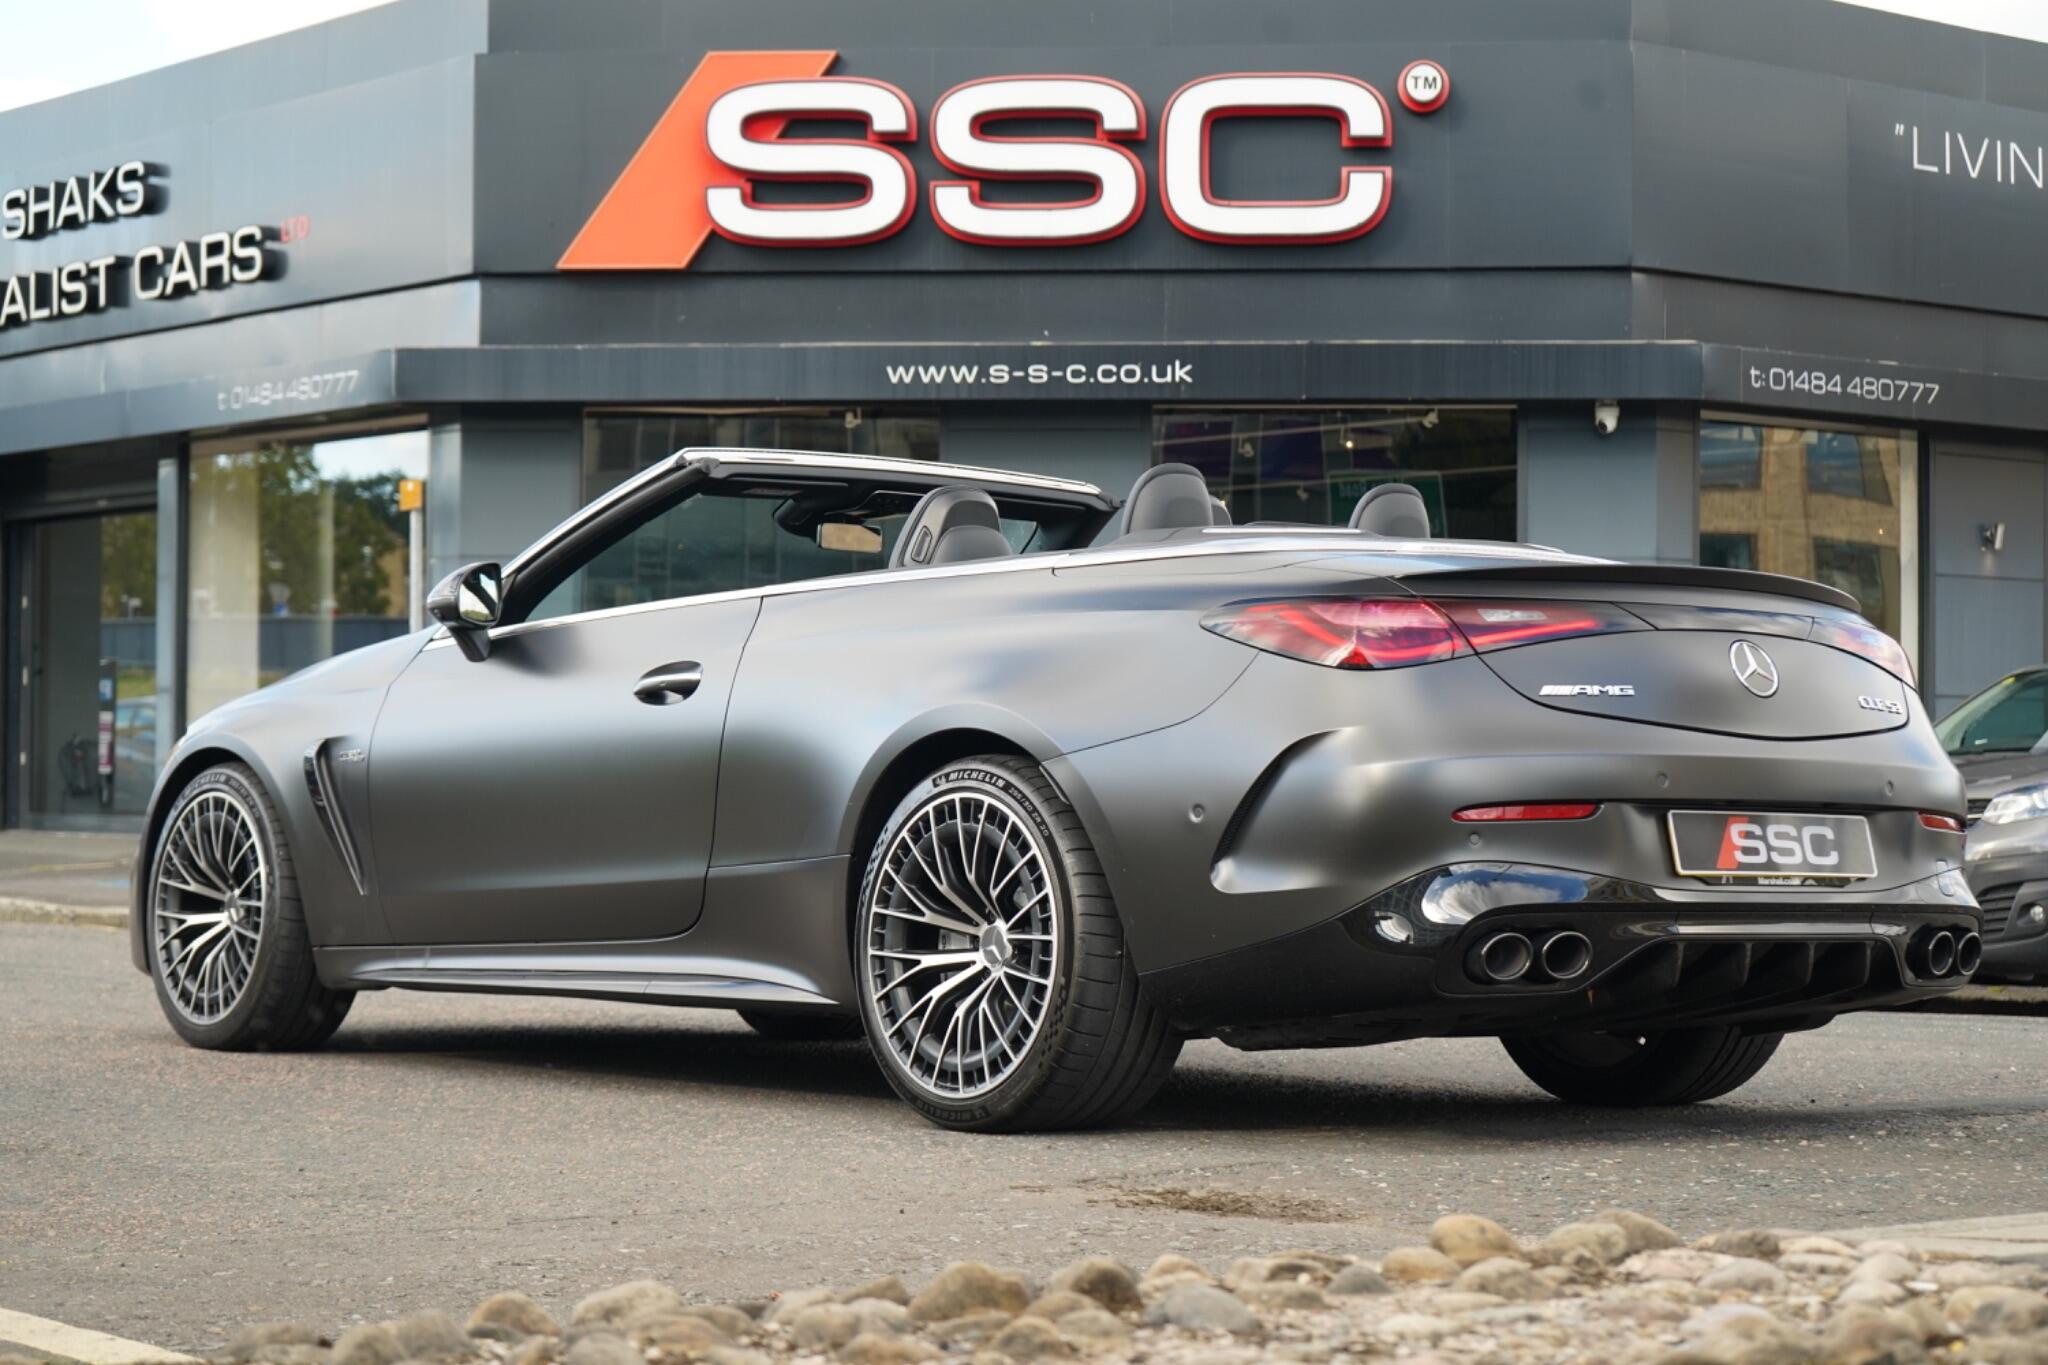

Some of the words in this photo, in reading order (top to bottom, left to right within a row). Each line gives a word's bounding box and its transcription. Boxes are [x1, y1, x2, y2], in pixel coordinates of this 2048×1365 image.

[704, 72, 1392, 247] SSC
[1410, 75, 1438, 90] TM
[1, 160, 147, 240] SHAKS
[0, 255, 118, 327] ALIST
[134, 225, 263, 300] CARS
[280, 215, 311, 244] LTD
[886, 359, 1194, 385] www.s-s-c.co.uk
[1846, 376, 1940, 405] 480777
[948, 768, 1007, 788] MICHELIN
[1730, 822, 1840, 866] SSC
